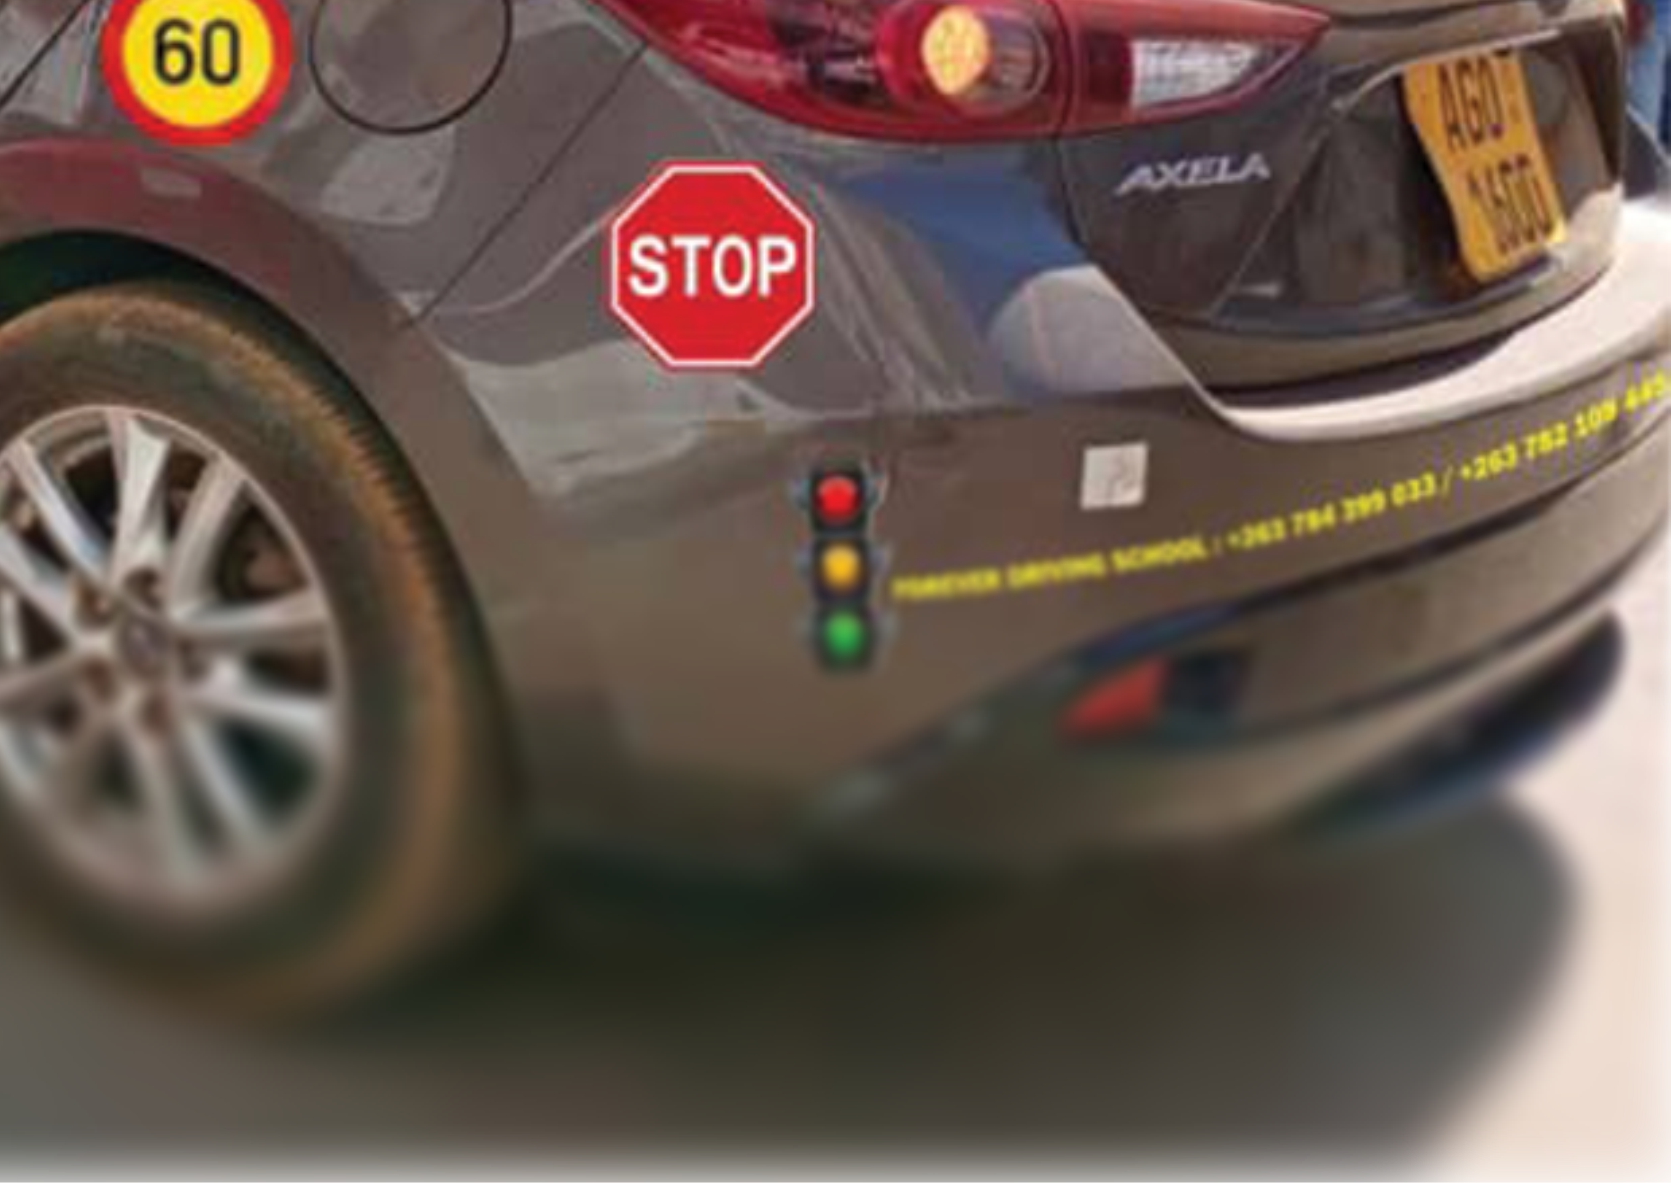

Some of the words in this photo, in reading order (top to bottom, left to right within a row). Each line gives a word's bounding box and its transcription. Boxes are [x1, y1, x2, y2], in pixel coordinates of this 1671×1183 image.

[154, 19, 241, 86] 60
[1114, 151, 1271, 196] AXELA
[628, 234, 798, 299] STOP
[891, 568, 1001, 600] FOREVER
[1007, 552, 1107, 588] DRIVING
[1111, 537, 1208, 572] SCHOOL
[1227, 519, 1285, 549] +263
[1461, 441, 1518, 481] +263
